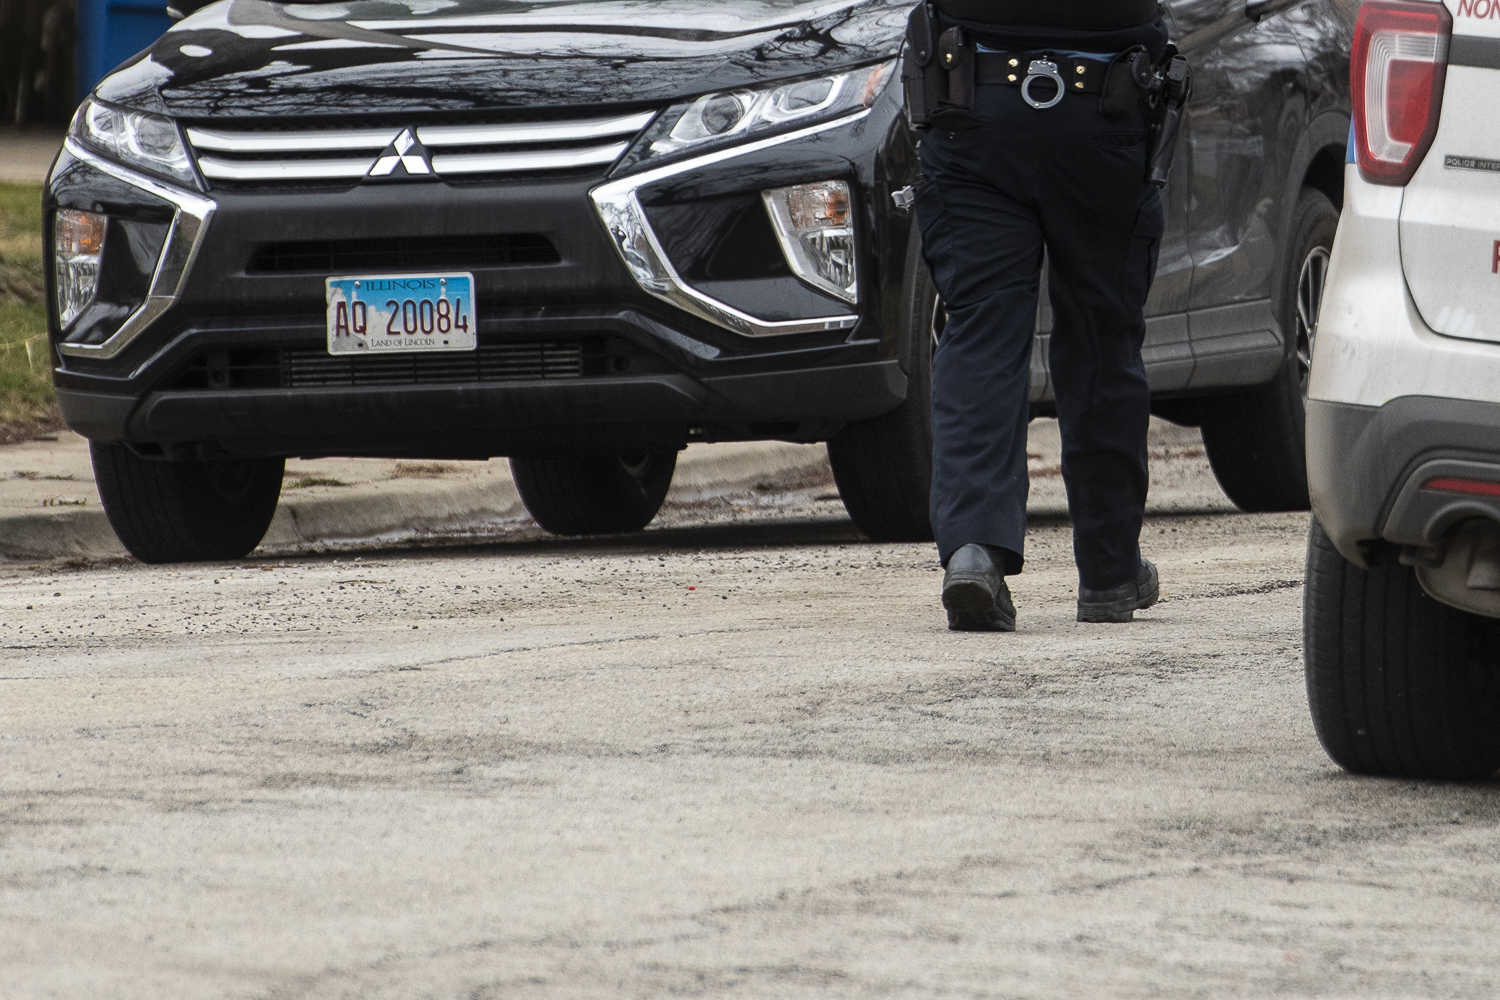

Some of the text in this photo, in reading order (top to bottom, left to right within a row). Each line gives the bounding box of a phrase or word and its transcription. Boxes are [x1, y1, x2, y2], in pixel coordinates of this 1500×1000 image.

[1445, 157, 1476, 167] POLICE
[366, 279, 436, 291] ILLINOIS
[335, 297, 469, 337] AQ 20084
